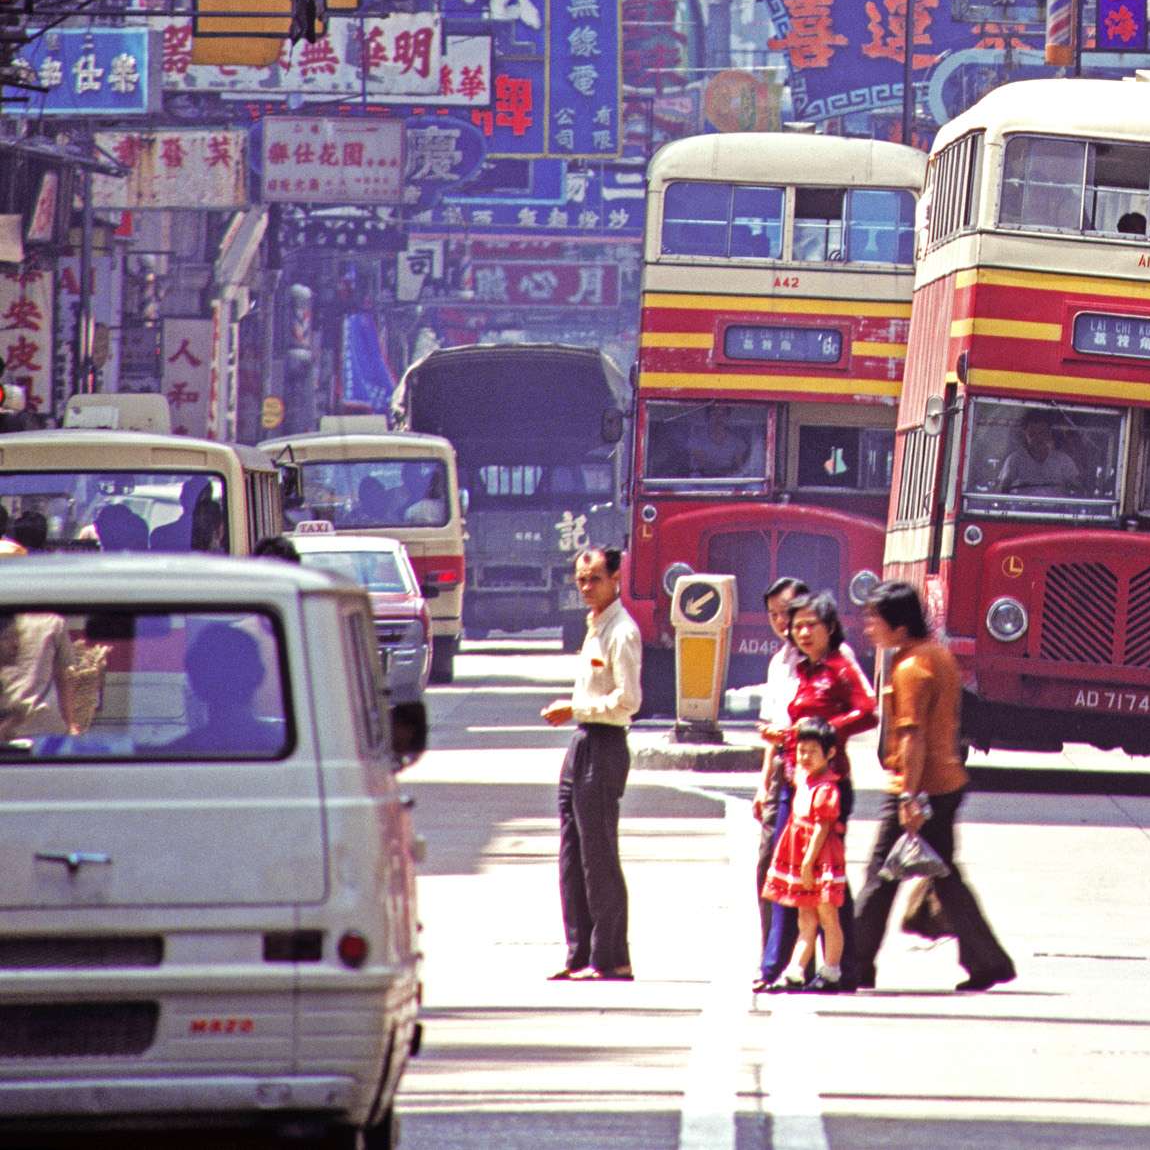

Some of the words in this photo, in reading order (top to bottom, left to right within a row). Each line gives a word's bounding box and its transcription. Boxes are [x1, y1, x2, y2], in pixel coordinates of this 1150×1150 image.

[773, 276, 801, 289] A42
[1091, 320, 1106, 332] LAI
[1115, 321, 1131, 335] CHI
[299, 522, 329, 533] TAXI
[1074, 688, 1099, 708] AD
[1107, 691, 1150, 713] 7174
